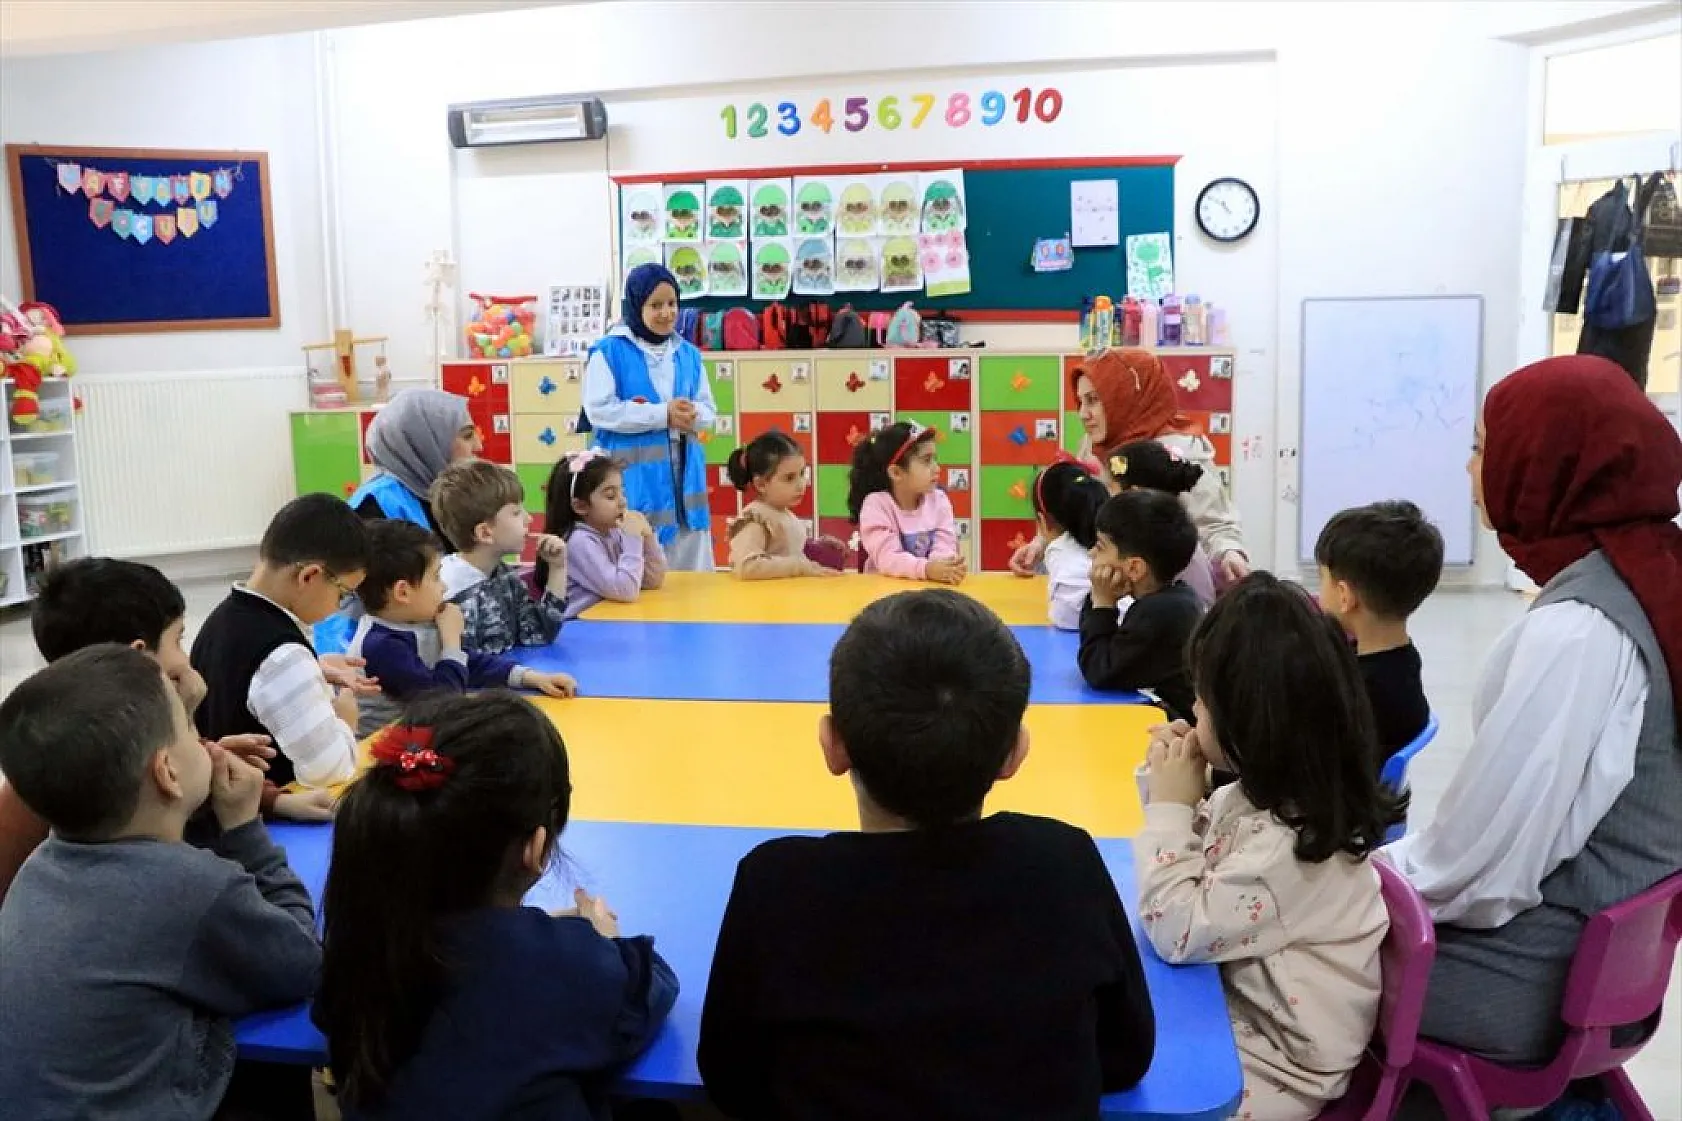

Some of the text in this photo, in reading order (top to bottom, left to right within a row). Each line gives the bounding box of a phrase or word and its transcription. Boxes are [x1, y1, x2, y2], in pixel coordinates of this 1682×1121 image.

[720, 87, 1063, 139] 1 2 3 4 5 6 7 8 9 10
